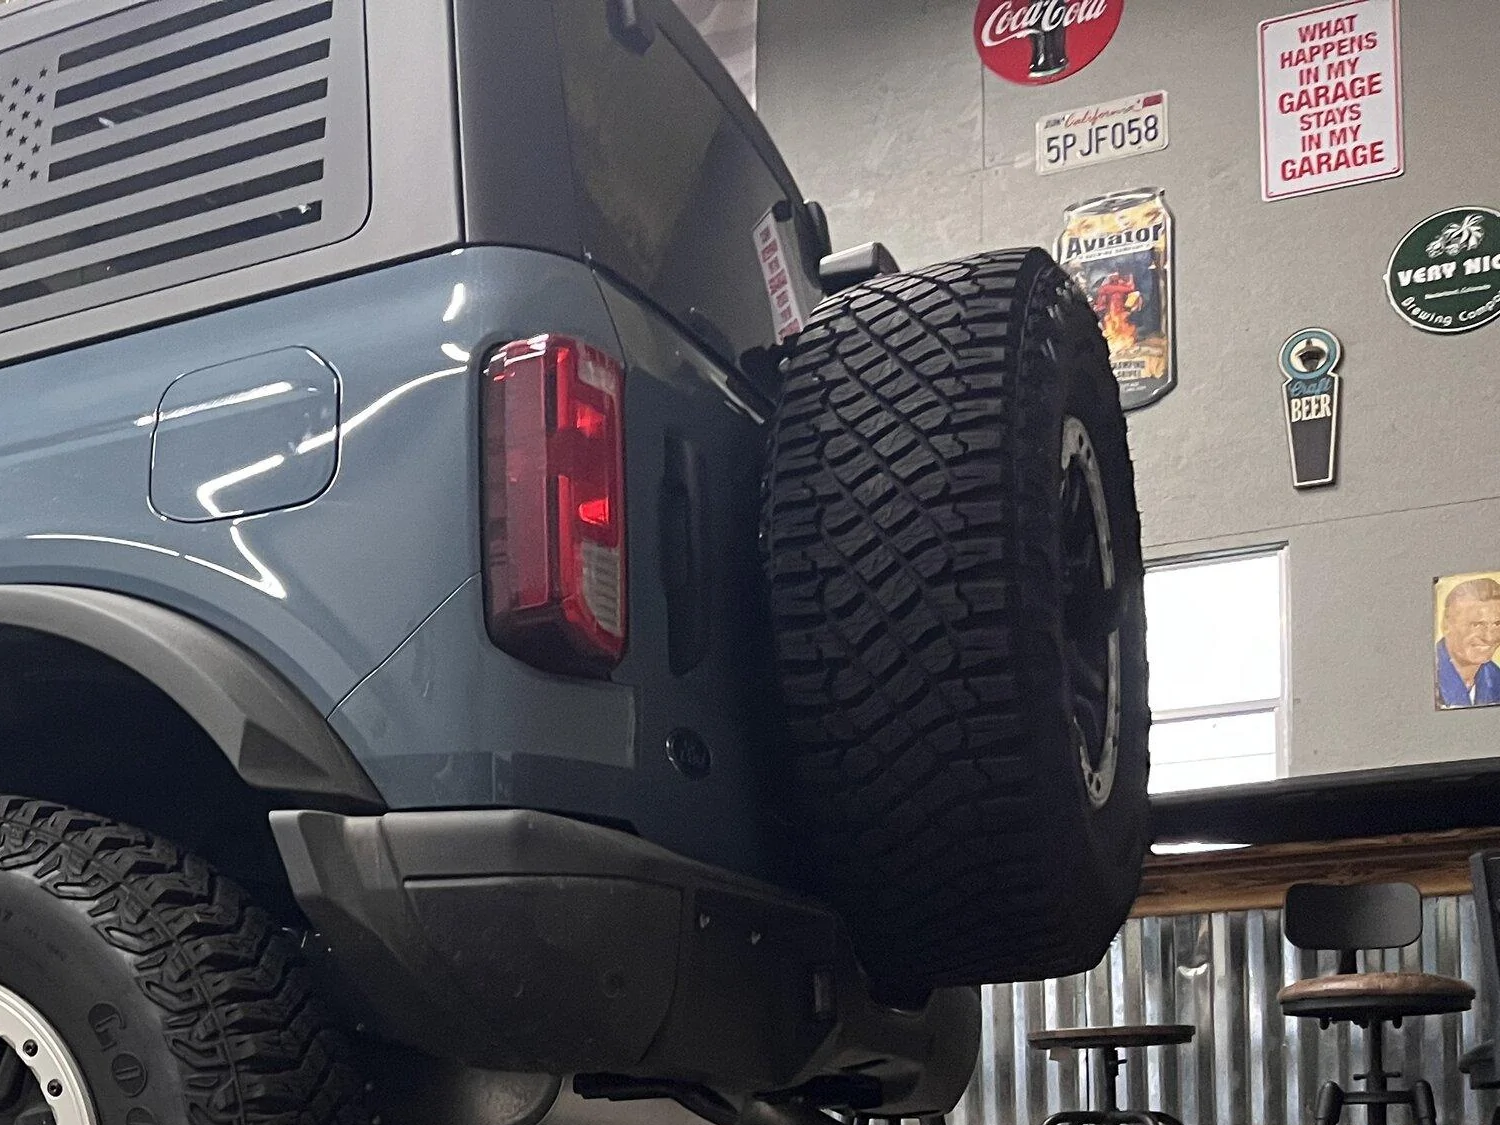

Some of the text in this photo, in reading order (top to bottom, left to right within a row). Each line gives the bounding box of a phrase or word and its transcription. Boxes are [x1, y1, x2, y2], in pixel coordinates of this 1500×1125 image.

[1298, 14, 1357, 43] WHAT
[1280, 31, 1378, 69] HAPPENS
[1299, 57, 1360, 86] IN MY
[1278, 73, 1382, 114] GARAGE
[1300, 103, 1362, 131] STAYS
[1046, 114, 1159, 163] 5PJF058
[1301, 124, 1361, 152] IN MY
[1280, 141, 1384, 181] GARAGE
[1066, 222, 1163, 259] Aviator
[1397, 261, 1457, 287] VERY
[1291, 394, 1331, 422] BEER
